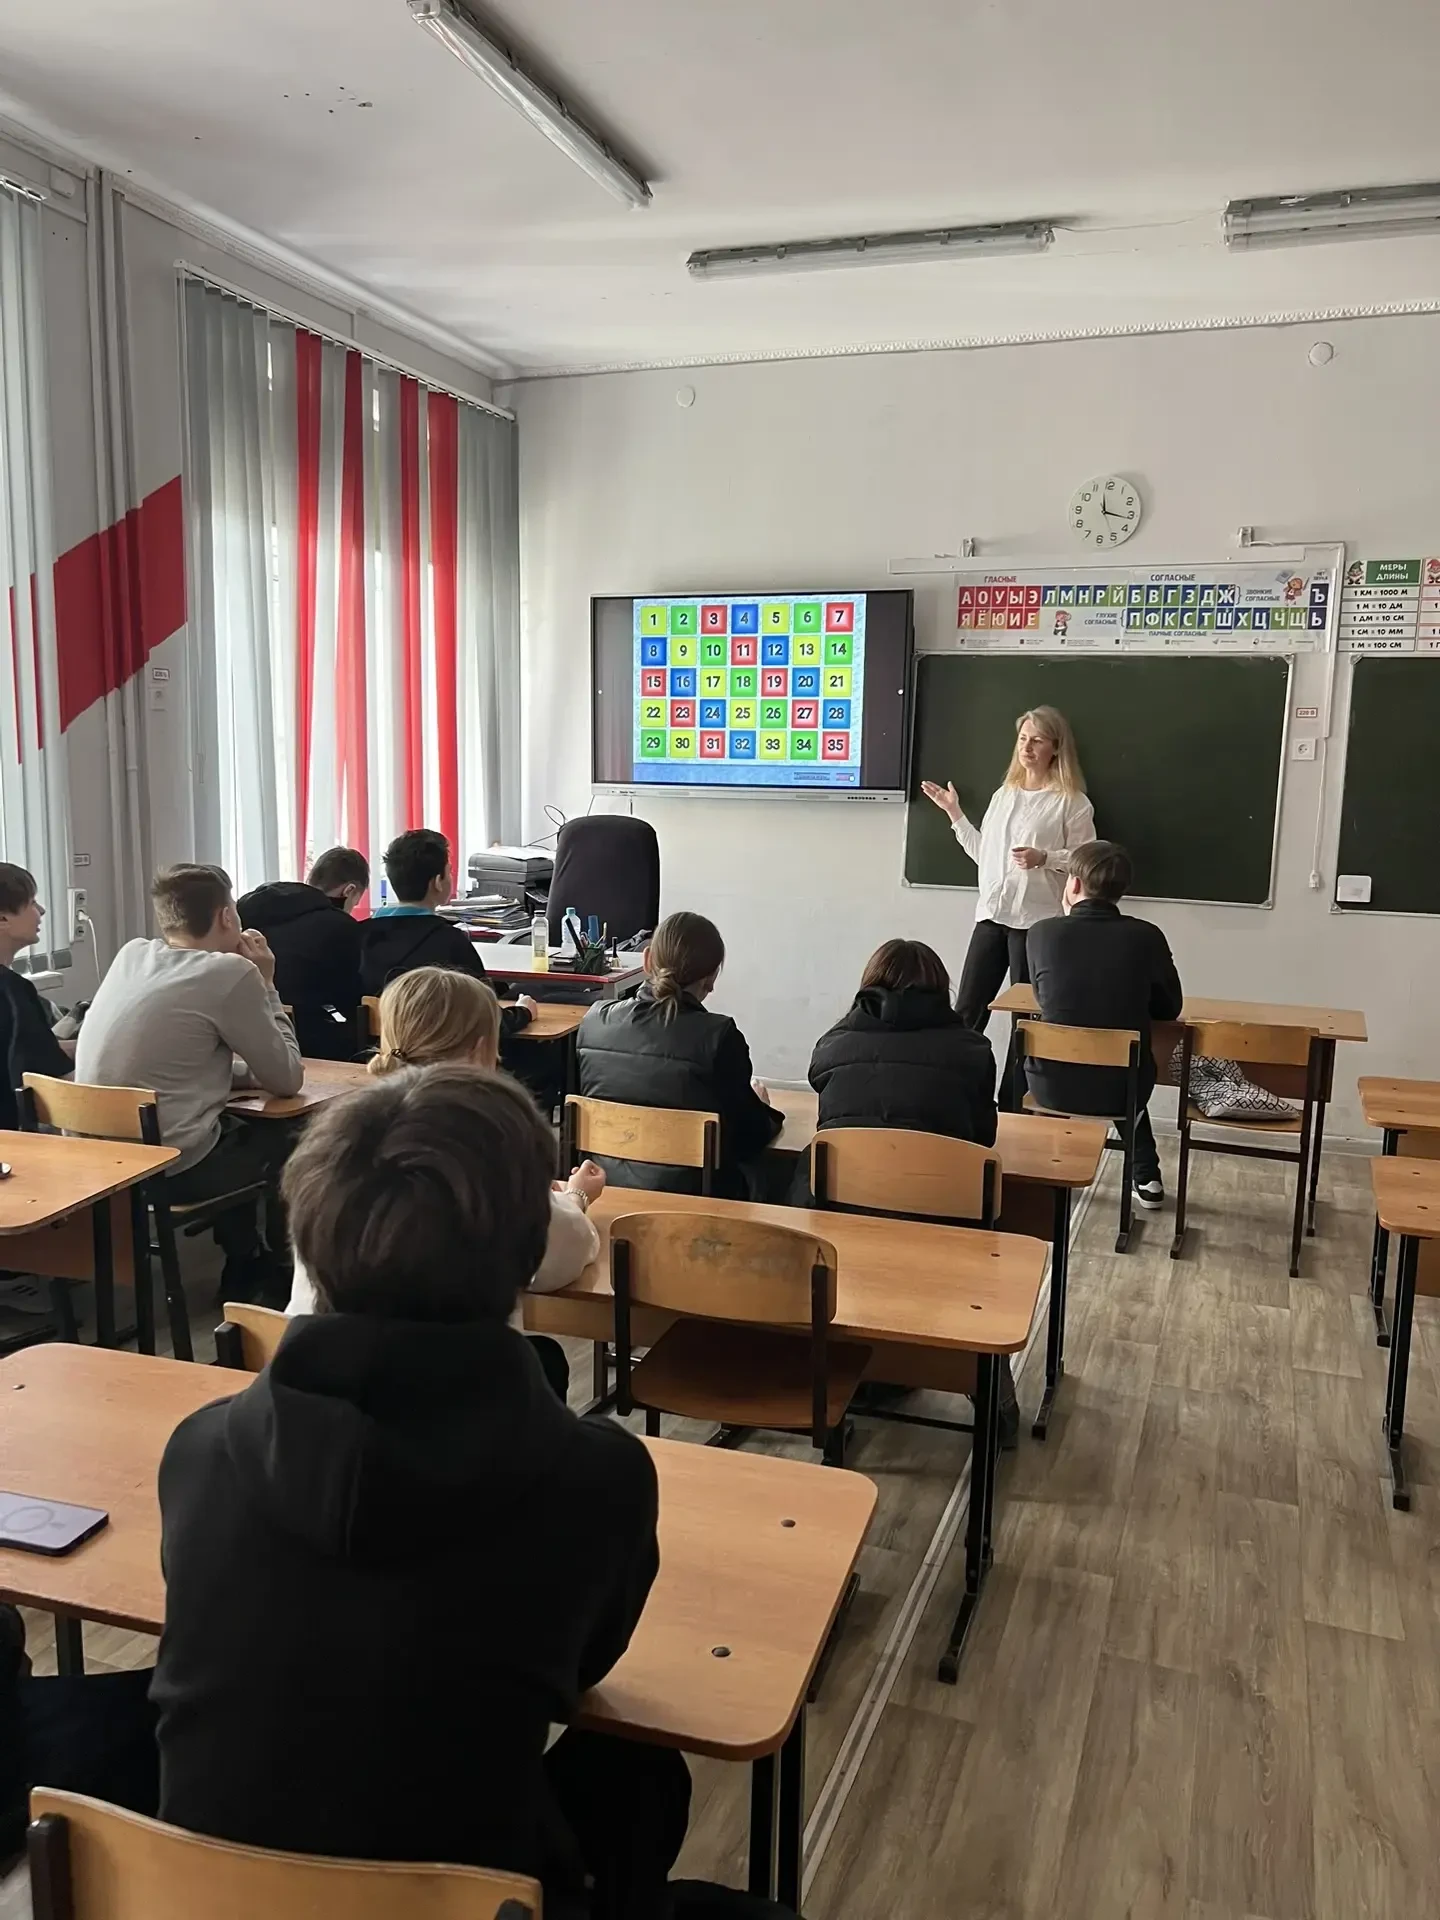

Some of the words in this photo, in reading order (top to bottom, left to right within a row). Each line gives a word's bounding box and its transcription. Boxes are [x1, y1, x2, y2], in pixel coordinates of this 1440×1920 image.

[1093, 484, 1099, 492] 11
[1105, 481, 1115, 490] 12
[1121, 486, 1124, 494] 1
[1081, 493, 1091, 502] 10
[1126, 497, 1134, 506] 2
[1075, 506, 1082, 514] 9
[1128, 511, 1135, 520] 3
[1076, 520, 1083, 528] 8
[1121, 524, 1128, 532] 4
[1084, 530, 1091, 538] 7
[1110, 532, 1117, 541] 5
[1096, 535, 1103, 544] 6
[1151, 574, 1196, 582] СОГЛАСНЫЕ
[961, 591, 972, 604] А
[978, 591, 987, 604] О
[995, 591, 1004, 604] У
[1009, 591, 1023, 604] Ы
[1029, 591, 1037, 604] Э
[1044, 590, 1055, 604] Л
[1060, 590, 1074, 603] М
[1076, 590, 1088, 603] Н
[1096, 590, 1105, 603] Р
[1113, 586, 1123, 603] Й
[1131, 590, 1141, 603] Б
[1149, 590, 1159, 603] В
[1167, 590, 1177, 603] Г
[1185, 590, 1194, 603] З
[1201, 590, 1214, 605] Д
[1218, 589, 1234, 603] Ж
[1311, 589, 1325, 603] Ъ
[650, 614, 656, 625] 1
[680, 613, 688, 625] 2
[710, 613, 718, 625] 3
[740, 612, 749, 624] 4
[772, 612, 780, 624] 5
[804, 611, 812, 623] 6
[835, 610, 844, 622] 7
[961, 613, 970, 626] Я
[979, 610, 986, 626] Ё
[992, 613, 1005, 626] Ю
[1009, 613, 1020, 626] И
[1028, 613, 1035, 626] Е
[1129, 613, 1141, 626] П
[1146, 612, 1160, 626] Ф
[1165, 613, 1175, 626] К
[1183, 613, 1193, 626] С
[1201, 613, 1212, 626] Т
[1217, 613, 1232, 626] Ш
[1237, 612, 1248, 626] Х
[1254, 612, 1267, 629] Ц
[1274, 612, 1284, 626] Ч
[1290, 612, 1307, 629] Щ
[1311, 613, 1322, 626] Ь
[650, 645, 657, 657] 8
[679, 645, 687, 656] 9
[706, 645, 721, 657] 10
[737, 644, 750, 656] 11
[768, 644, 783, 656] 12
[800, 644, 814, 655] 13
[831, 643, 846, 655] 14
[647, 676, 661, 687] 15
[676, 676, 690, 687] 16
[706, 676, 720, 687] 17
[737, 676, 750, 687] 18
[767, 676, 781, 687] 19
[798, 675, 813, 687] 20
[830, 675, 844, 687] 21
[646, 707, 660, 718] 22
[675, 707, 690, 718] 23
[705, 707, 720, 719] 24
[735, 707, 750, 719] 25
[766, 707, 781, 719] 26
[797, 707, 812, 719] 27
[828, 707, 844, 719] 28
[646, 737, 660, 749] 29
[675, 737, 690, 749] 30
[706, 738, 720, 749] 31
[735, 738, 750, 750] 32
[765, 738, 780, 750] 33
[796, 738, 812, 750] 34
[828, 739, 843, 751] 35
